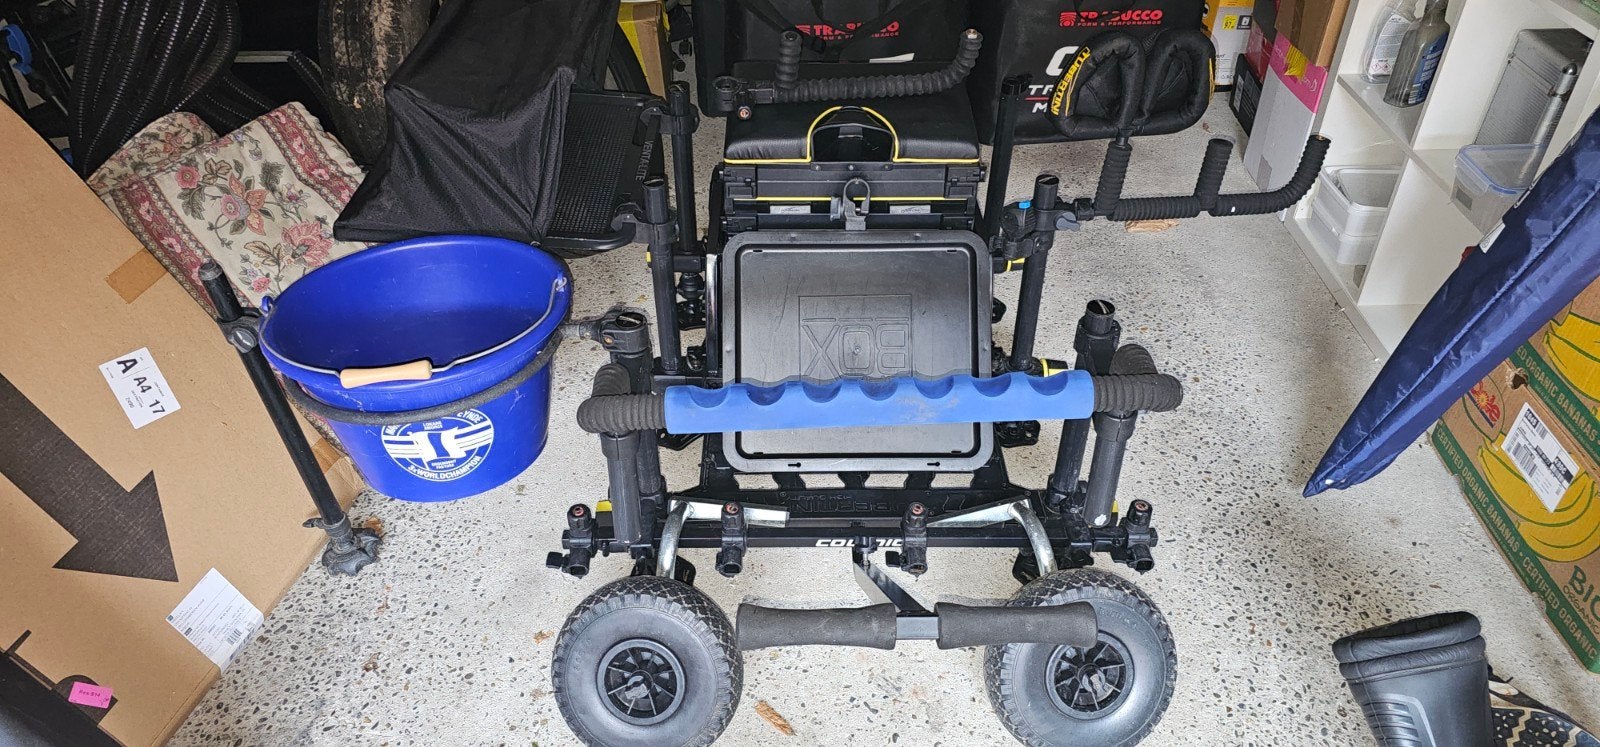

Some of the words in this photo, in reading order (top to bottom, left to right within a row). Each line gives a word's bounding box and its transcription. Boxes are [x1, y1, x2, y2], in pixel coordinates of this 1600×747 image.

[116, 358, 138, 374] A
[133, 376, 152, 393] A4
[149, 399, 165, 414] 17
[1557, 393, 1598, 442] BANANAS
[1437, 428, 1464, 470] CERTIFIED
[1461, 466, 1487, 508] ORGANIC
[1486, 502, 1520, 553] BANANAS
[1522, 556, 1560, 610] CERTIFIED
[1559, 607, 1598, 660] ORGANIC
